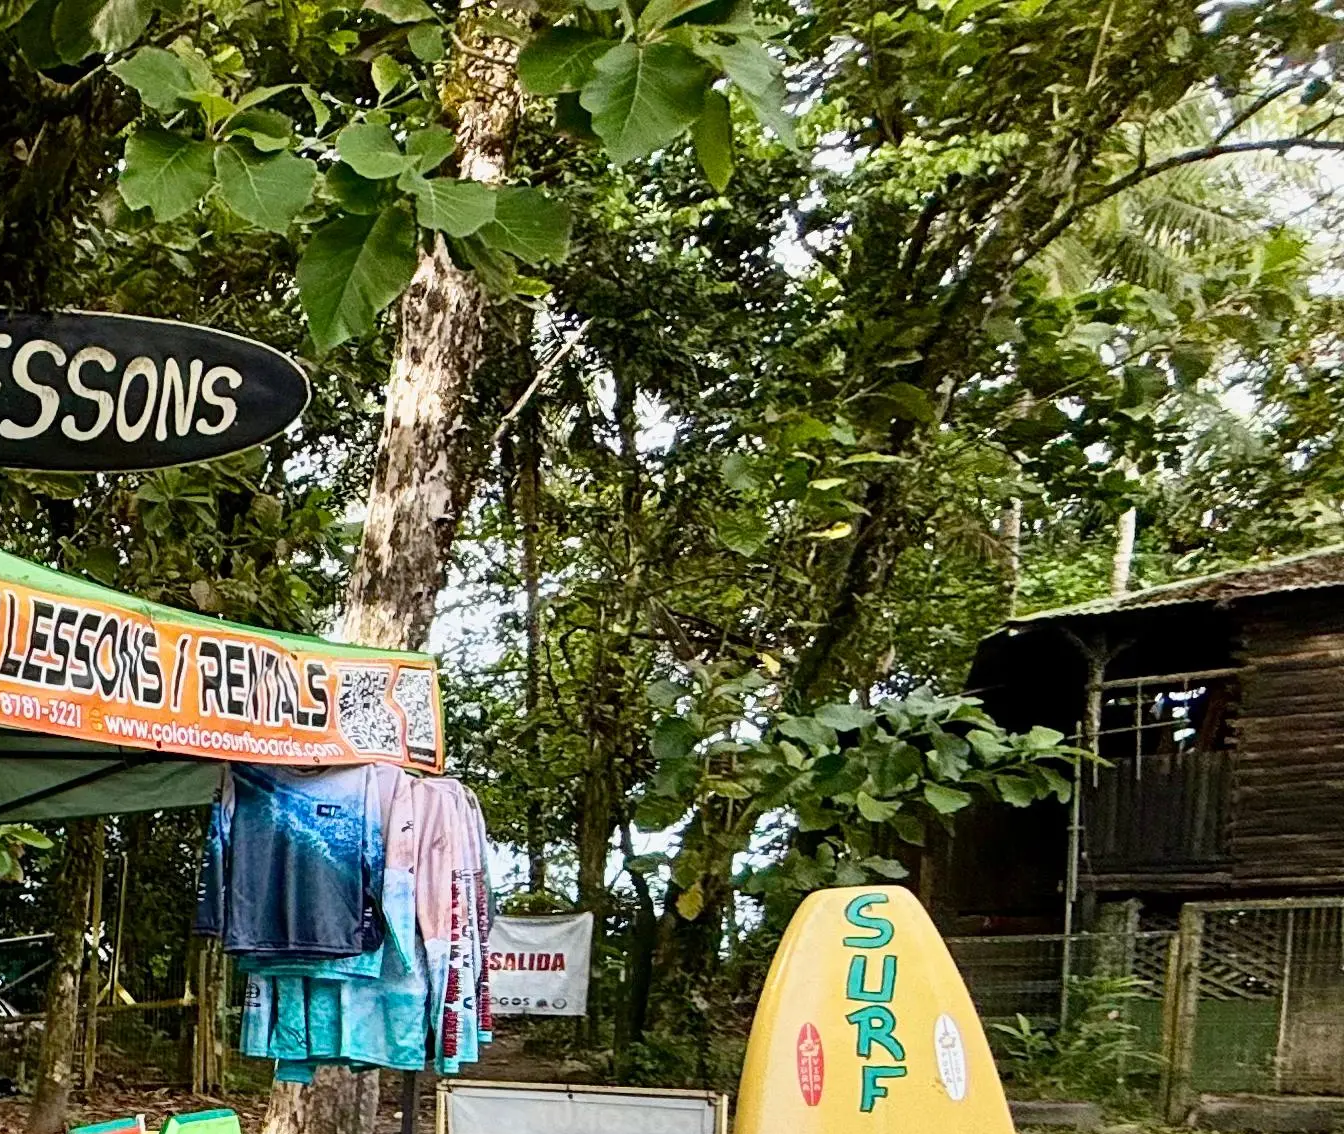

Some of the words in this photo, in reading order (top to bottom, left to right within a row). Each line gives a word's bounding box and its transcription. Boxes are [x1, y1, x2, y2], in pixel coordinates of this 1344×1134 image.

[172, 637, 189, 709] /
[196, 640, 329, 728] RENTALS
[0, 691, 82, 728] 8781-3221
[103, 714, 345, 757] www.coloticosurfboards.com
[489, 952, 566, 972] SALIDA
[842, 893, 907, 1113] SURF
